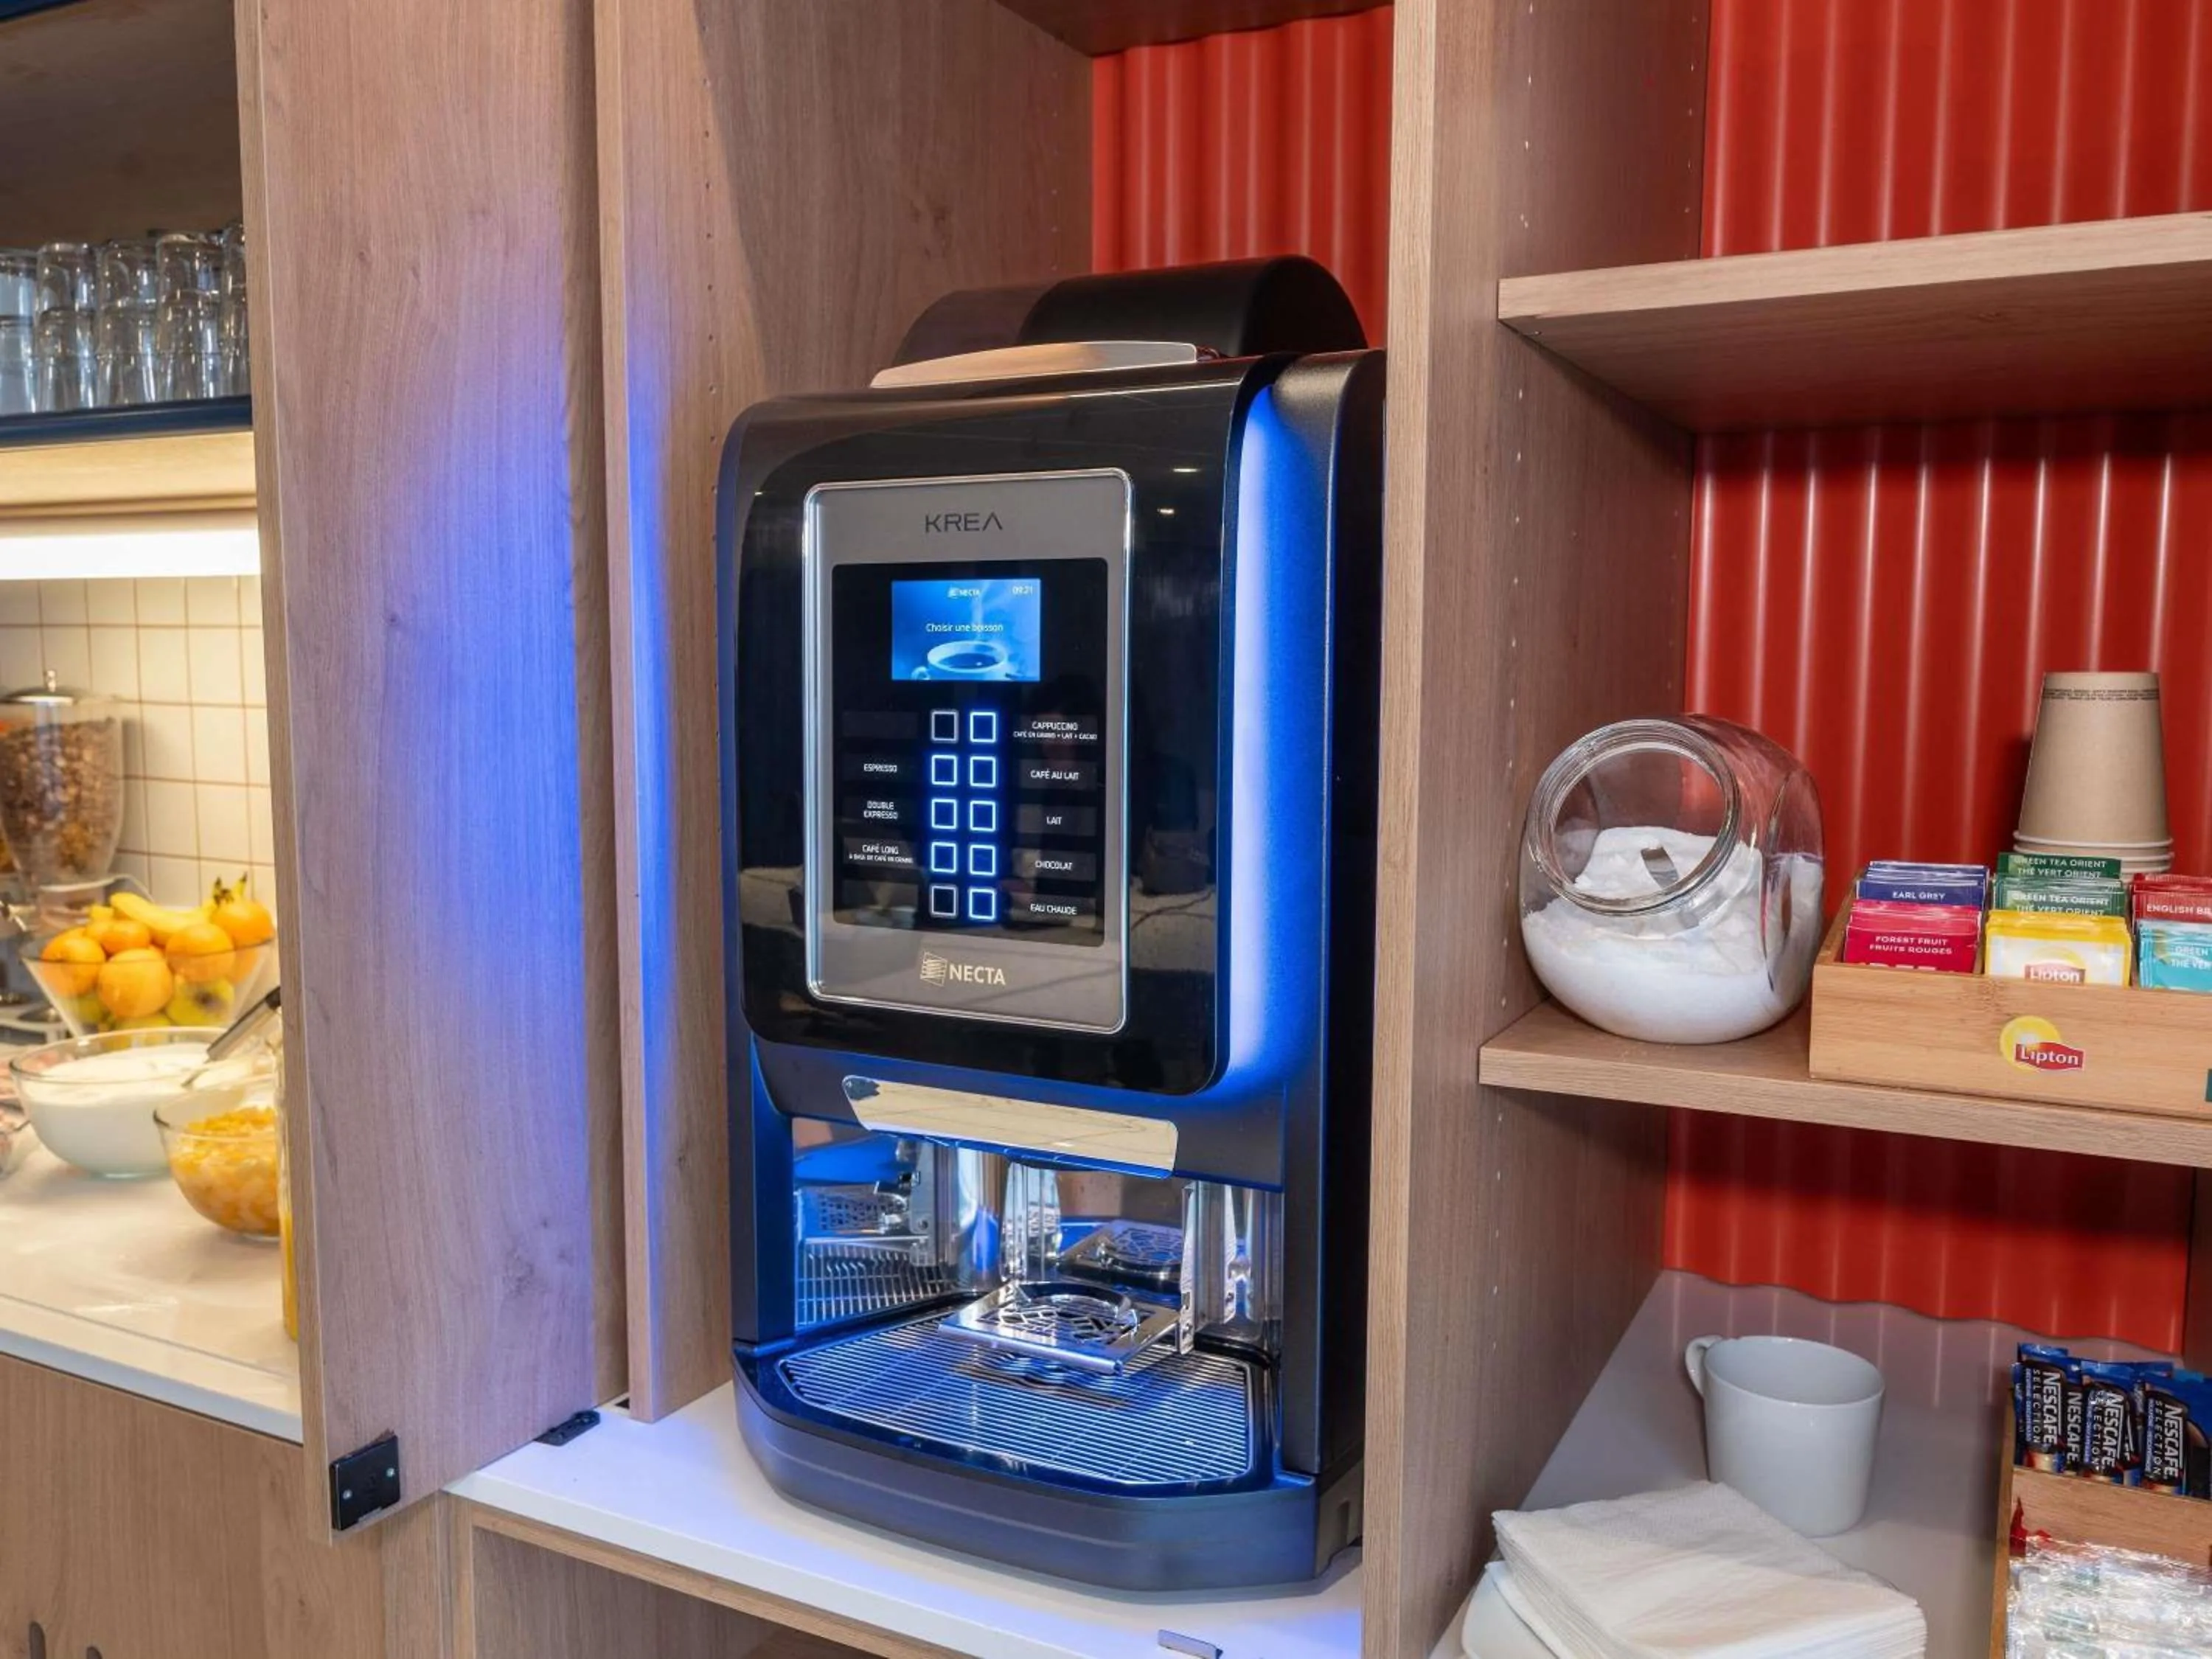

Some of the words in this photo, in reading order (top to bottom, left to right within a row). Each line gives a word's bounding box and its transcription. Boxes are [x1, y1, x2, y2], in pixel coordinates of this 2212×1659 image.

[926, 623, 952, 632] Choisir
[973, 623, 1004, 633] boisson
[1032, 722, 1078, 730] CAPPUCCINO
[1030, 769, 1050, 779] CAFÉ
[867, 801, 894, 810] DOUBLE
[1046, 815, 1062, 825] LAIT
[862, 844, 880, 853] CAFÉ
[881, 846, 899, 855] LONG
[1034, 860, 1073, 870] CHOCOLAT
[2049, 858, 2067, 866] TEA
[2070, 859, 2107, 868] ORIENT
[2037, 868, 2062, 877] VERT
[2065, 870, 2101, 879] ORIENT
[1892, 891, 1916, 899] EARL
[1919, 892, 1946, 900] GREY
[2011, 892, 2046, 902] GREEN
[2049, 894, 2068, 902] TEA
[2070, 896, 2110, 905] ORIENT
[1030, 903, 1045, 912] EAU
[1047, 905, 1077, 915] CHAUDE
[2037, 905, 2063, 914] VERT
[2065, 908, 2105, 916] ORIENT
[2146, 904, 2194, 914] ENGLISH
[1876, 936, 1914, 944] FOREST
[1918, 937, 1948, 945] FRUIT
[1870, 945, 1905, 953] FRUITS
[1908, 946, 1952, 955] ROUGES
[2175, 945, 2208, 956] GREEN
[949, 964, 1006, 985] NECTA
[2031, 967, 2080, 983] Lipton
[2021, 1045, 2079, 1065] Lipton
[2033, 1368, 2042, 1443] SELECTION
[2153, 1400, 2163, 1475] SELECTION
